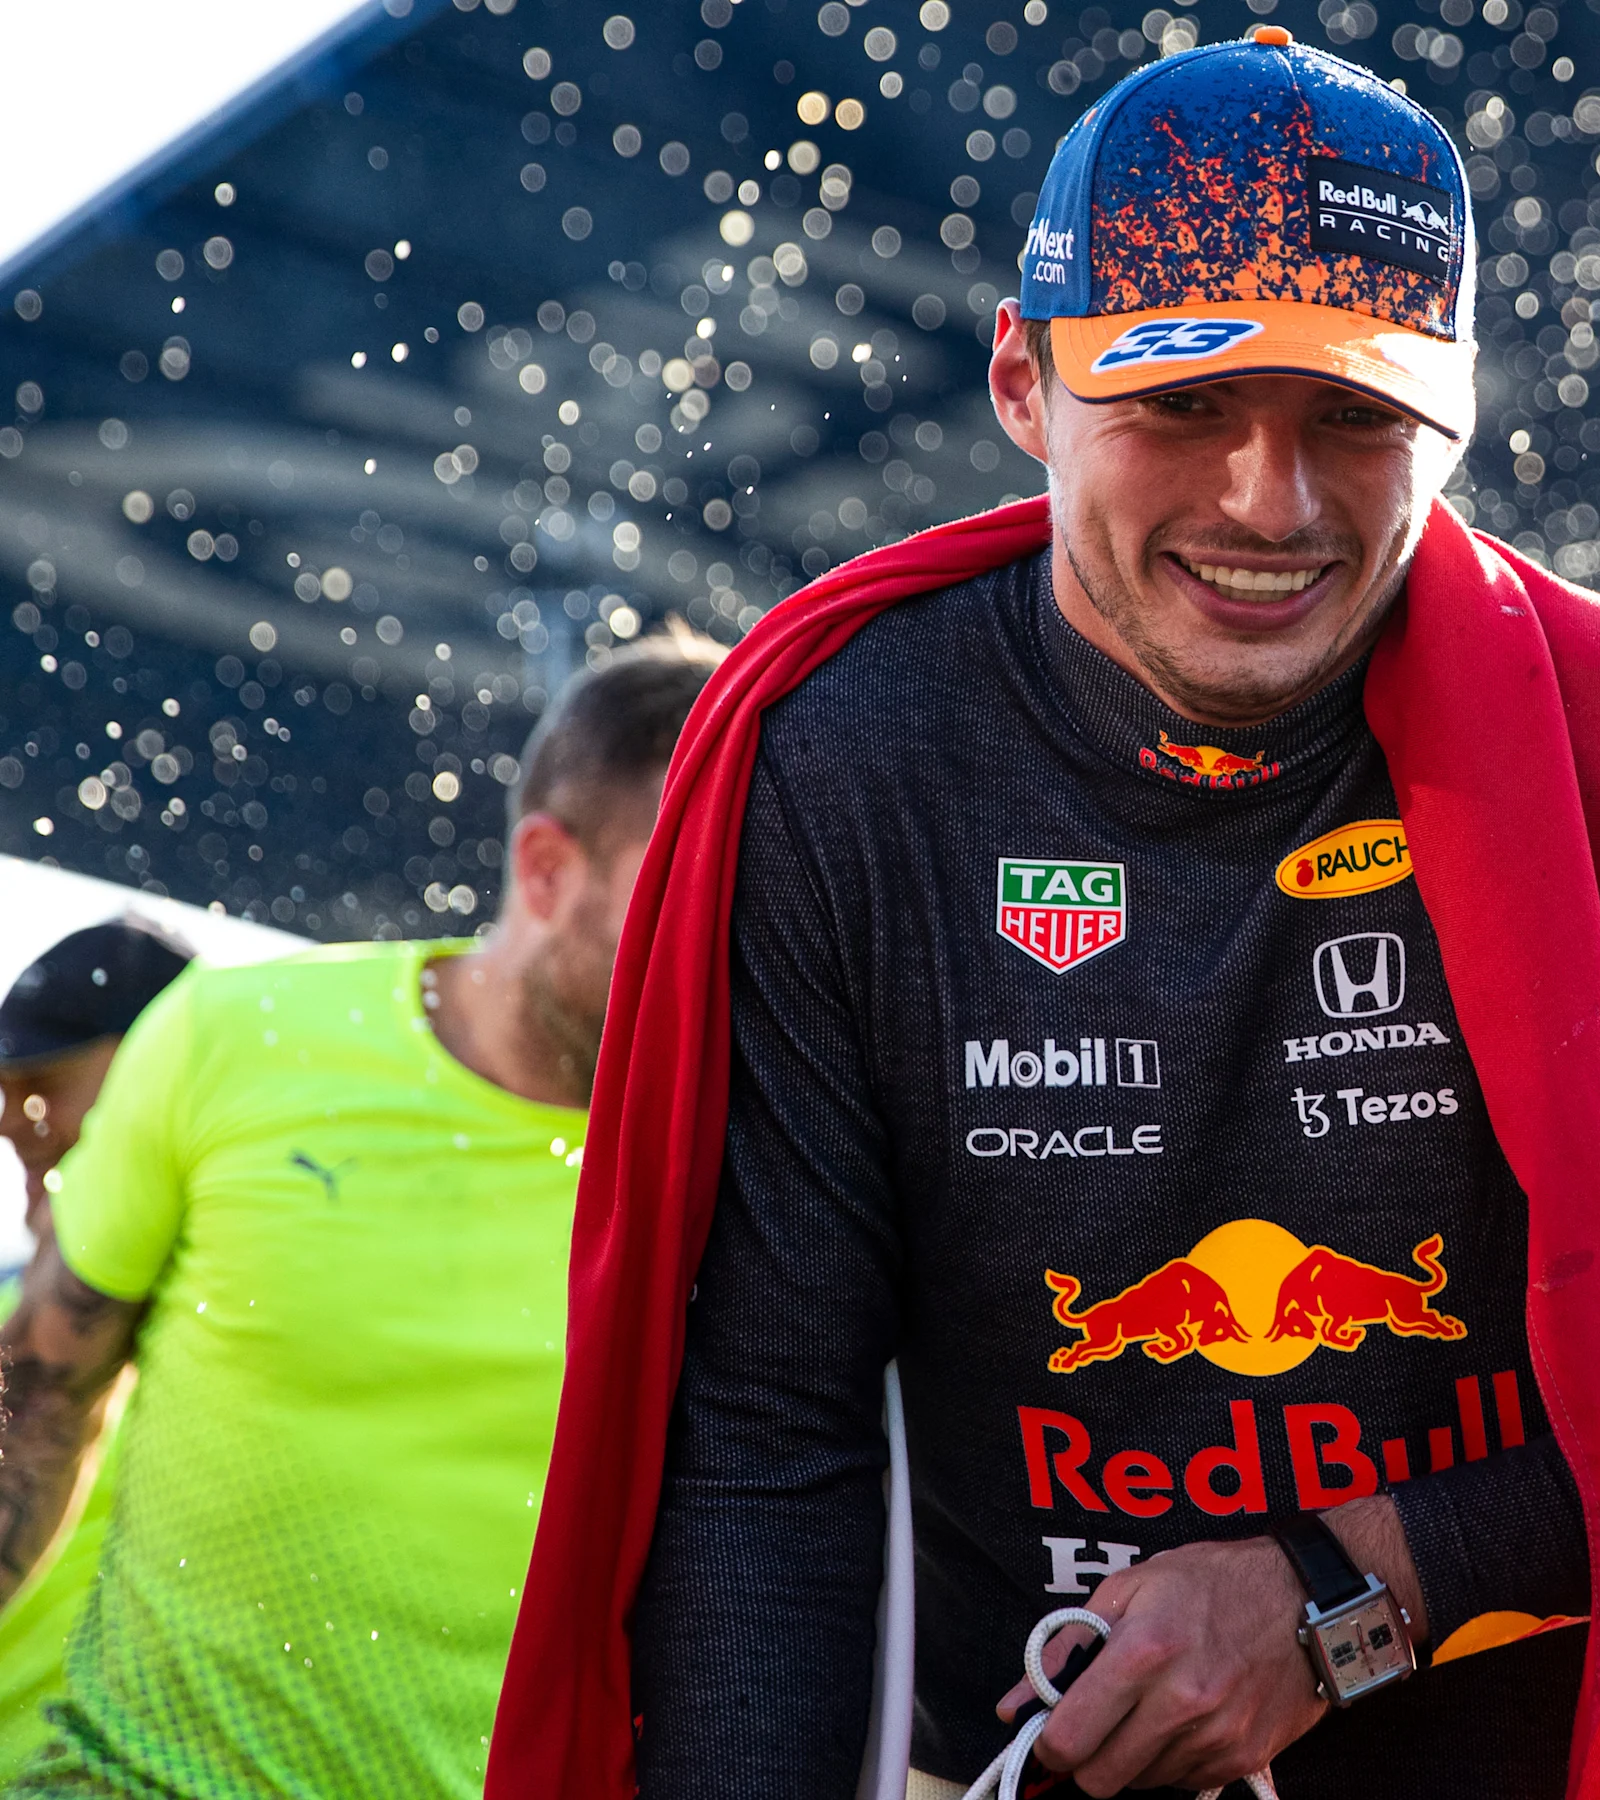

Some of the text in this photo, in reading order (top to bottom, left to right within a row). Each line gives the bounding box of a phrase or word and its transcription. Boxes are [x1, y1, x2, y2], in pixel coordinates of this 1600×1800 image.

[1318, 180, 1397, 216] Red Bull
[1319, 213, 1449, 262] RACING
[1032, 260, 1066, 284] .com
[1092, 318, 1264, 373] 33
[1010, 867, 1113, 902] TAG
[1005, 910, 1118, 964] HEUER
[1283, 1022, 1450, 1063] HONDA
[965, 1038, 1107, 1089] Mobil
[1336, 1088, 1459, 1126] Tezos
[965, 1125, 1164, 1160] ORACLE
[1017, 1400, 1269, 1518] Red
